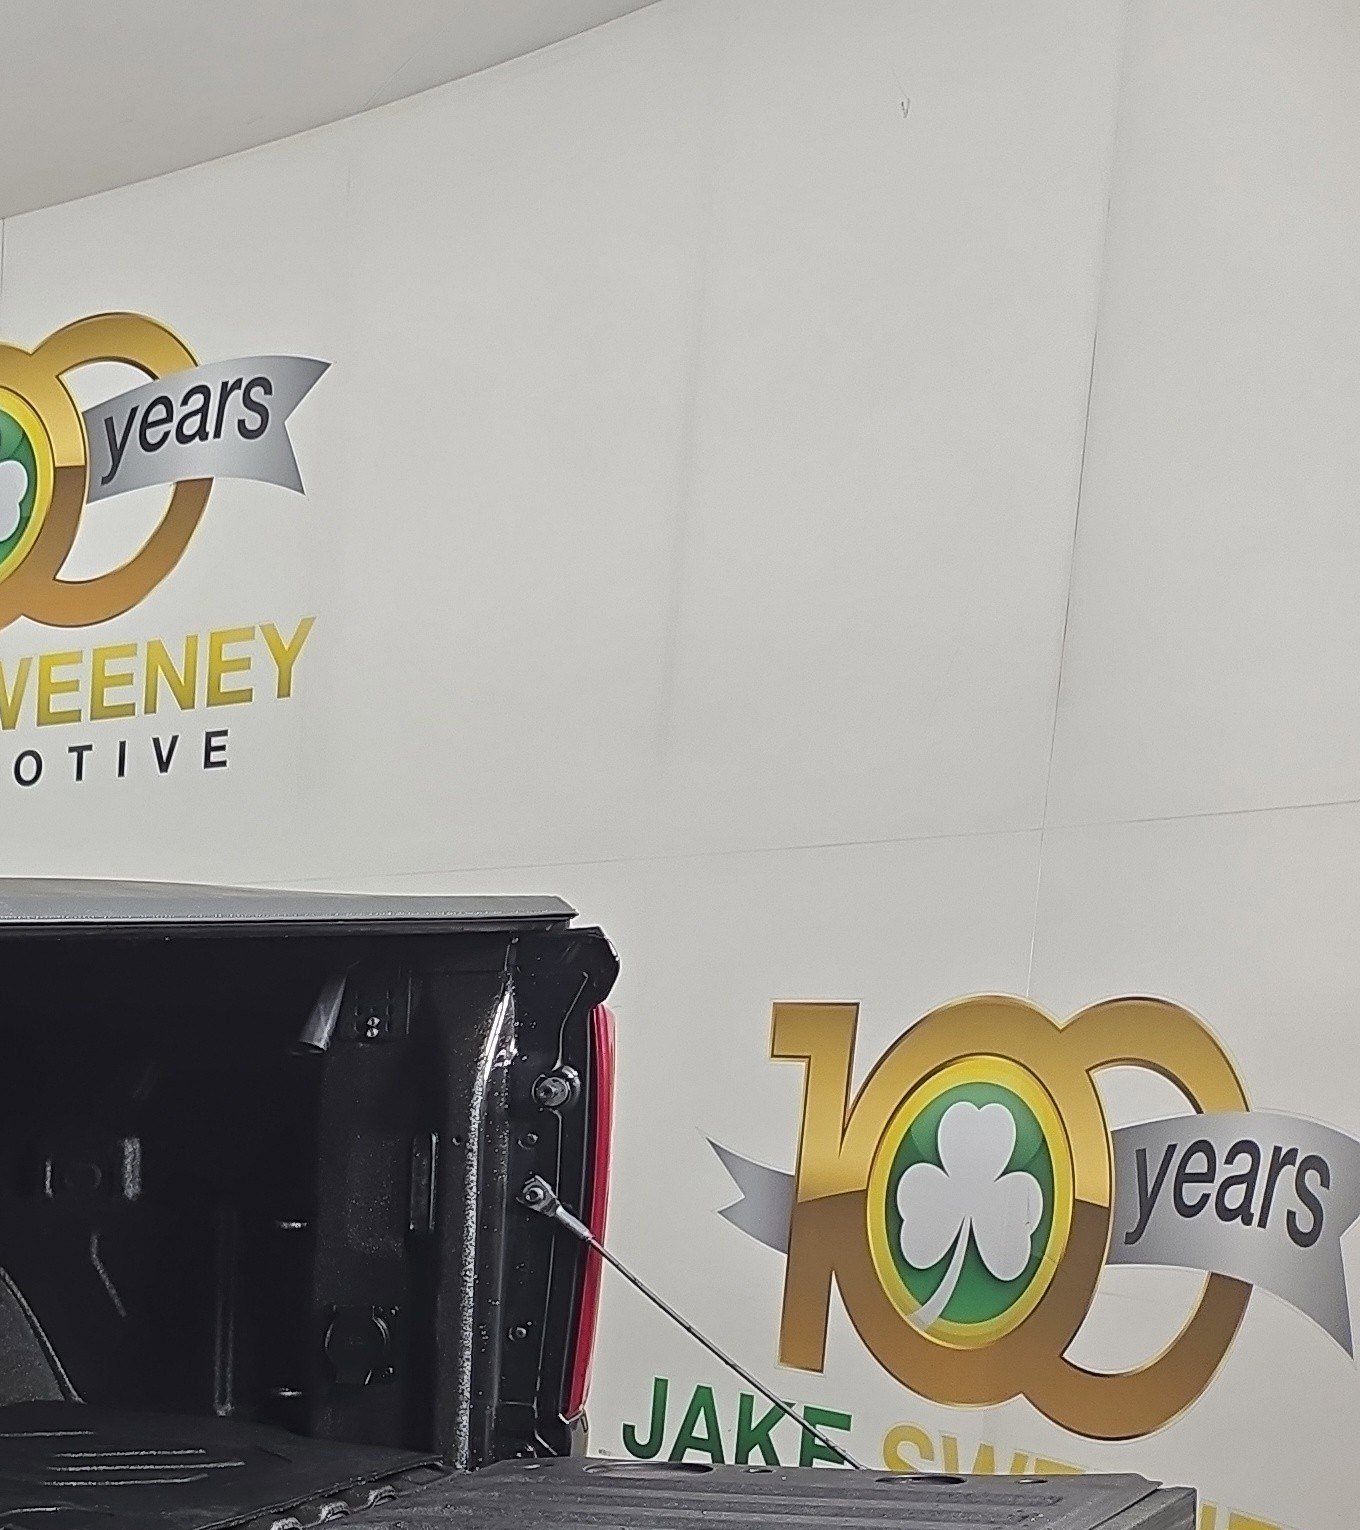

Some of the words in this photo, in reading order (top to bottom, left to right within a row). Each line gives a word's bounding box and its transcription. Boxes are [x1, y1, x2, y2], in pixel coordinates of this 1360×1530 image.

[101, 375, 273, 485] years
[771, 995, 1252, 1441] 100
[1124, 1137, 1331, 1247] years
[622, 1376, 853, 1467] JAKE
